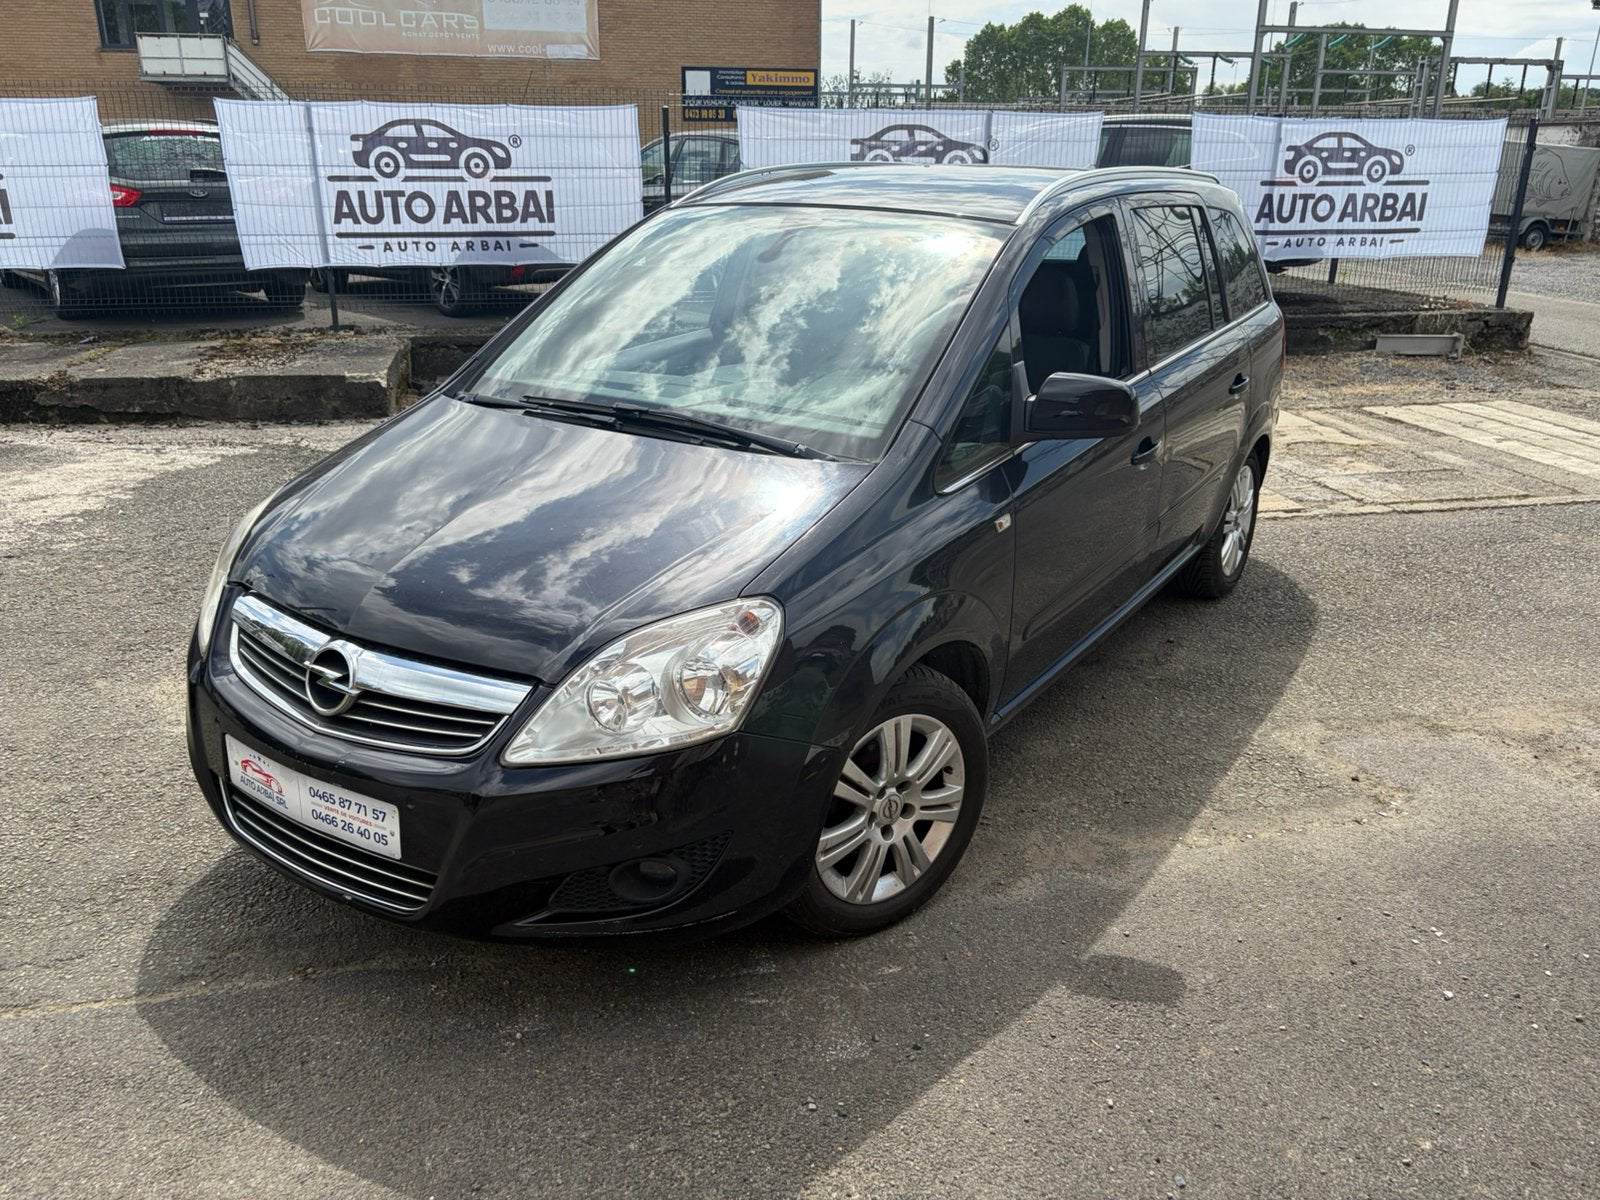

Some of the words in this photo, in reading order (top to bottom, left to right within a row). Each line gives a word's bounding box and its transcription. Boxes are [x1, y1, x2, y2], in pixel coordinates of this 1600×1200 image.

[750, 73, 810, 84] Yakimmo
[333, 190, 436, 225] AUTO
[443, 190, 555, 224] ARBAI
[1254, 193, 1336, 224] AUTO
[1337, 192, 1428, 223] ARBAI
[383, 240, 436, 253] AUTO
[450, 240, 511, 252] ARBAI
[1283, 237, 1326, 249] AUTO
[1336, 236, 1385, 247] ARBAI
[240, 775, 256, 791] AUTO
[275, 795, 289, 810] SRL
[309, 786, 336, 805] 0465
[338, 797, 353, 811] 87
[354, 802, 367, 817] 71
[372, 808, 387, 823] 57
[311, 809, 338, 828] 0466
[340, 819, 355, 834] 26
[356, 826, 371, 840] 40
[373, 832, 388, 846] 05
[323, 804, 340, 815] VENTE
[348, 814, 373, 827] VOITURES
